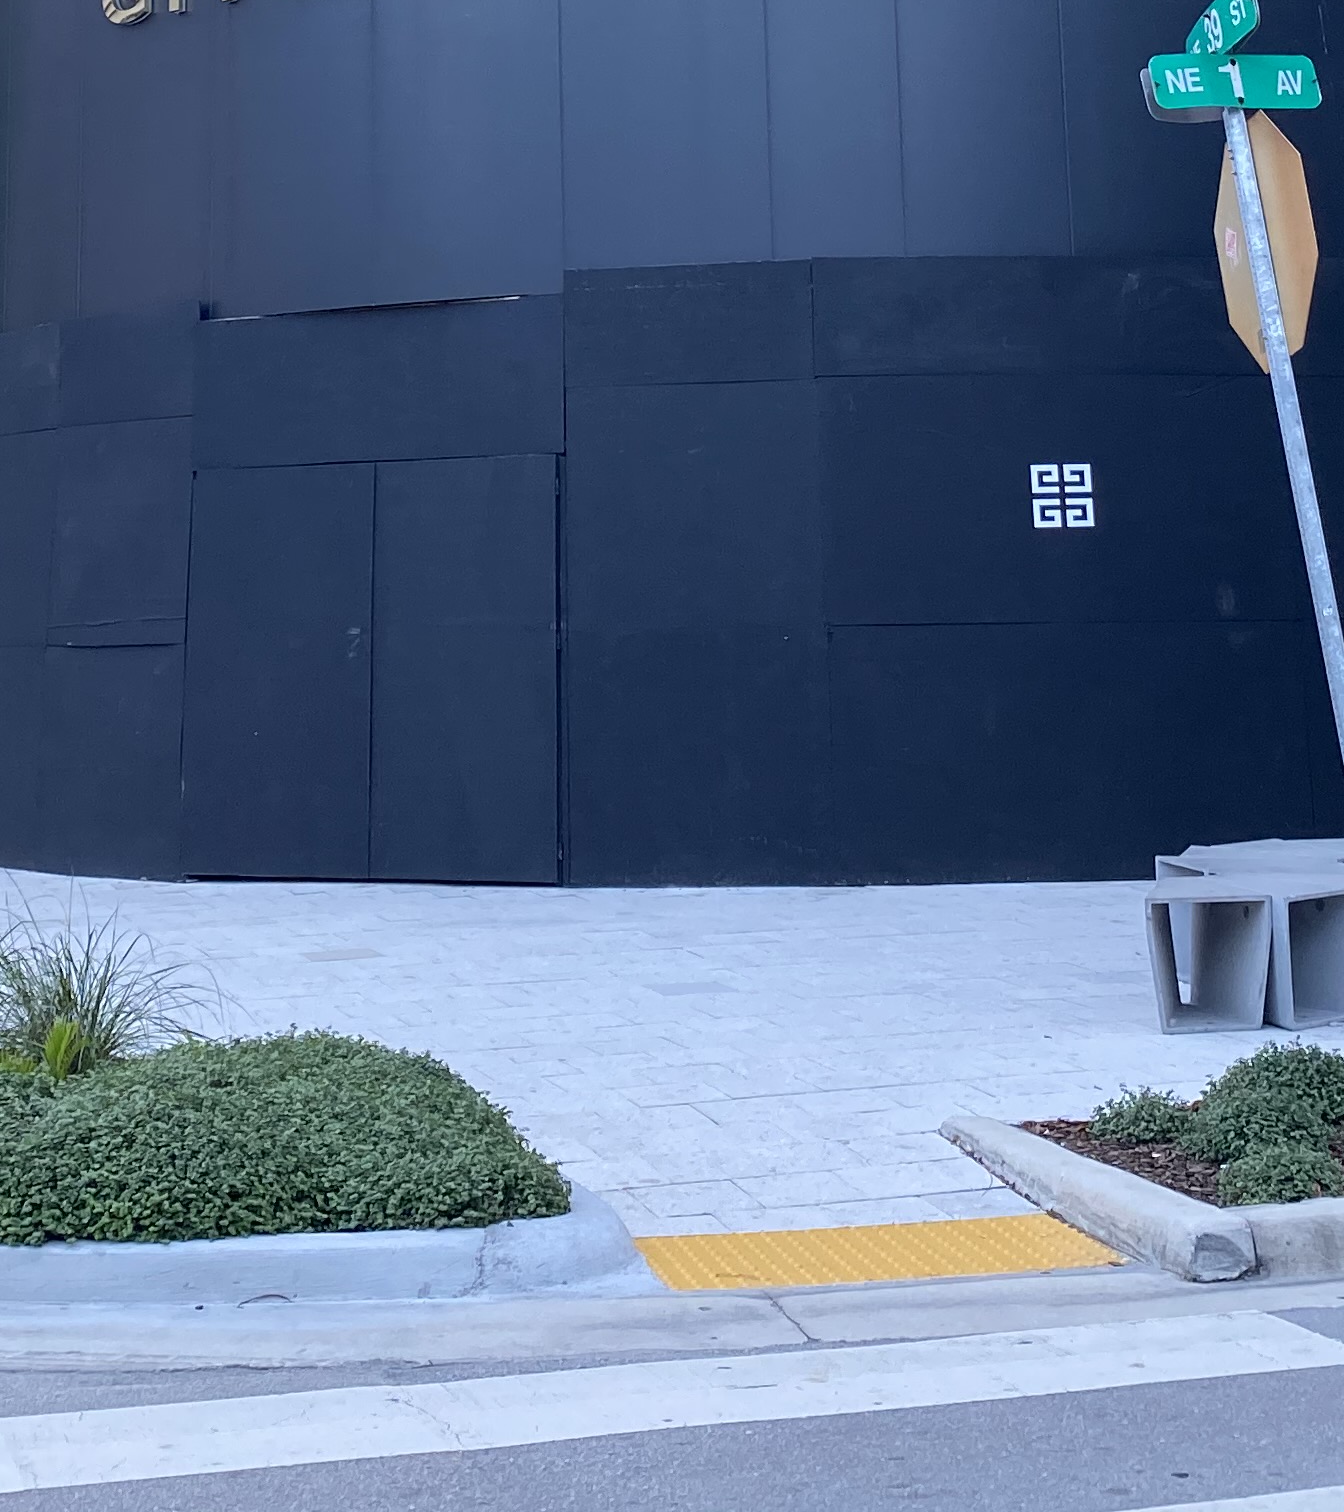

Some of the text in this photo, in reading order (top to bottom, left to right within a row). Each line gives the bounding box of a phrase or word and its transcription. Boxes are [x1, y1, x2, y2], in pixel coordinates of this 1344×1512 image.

[1204, 8, 1223, 53] 39
[1164, 58, 1302, 101] NE 1 AV
